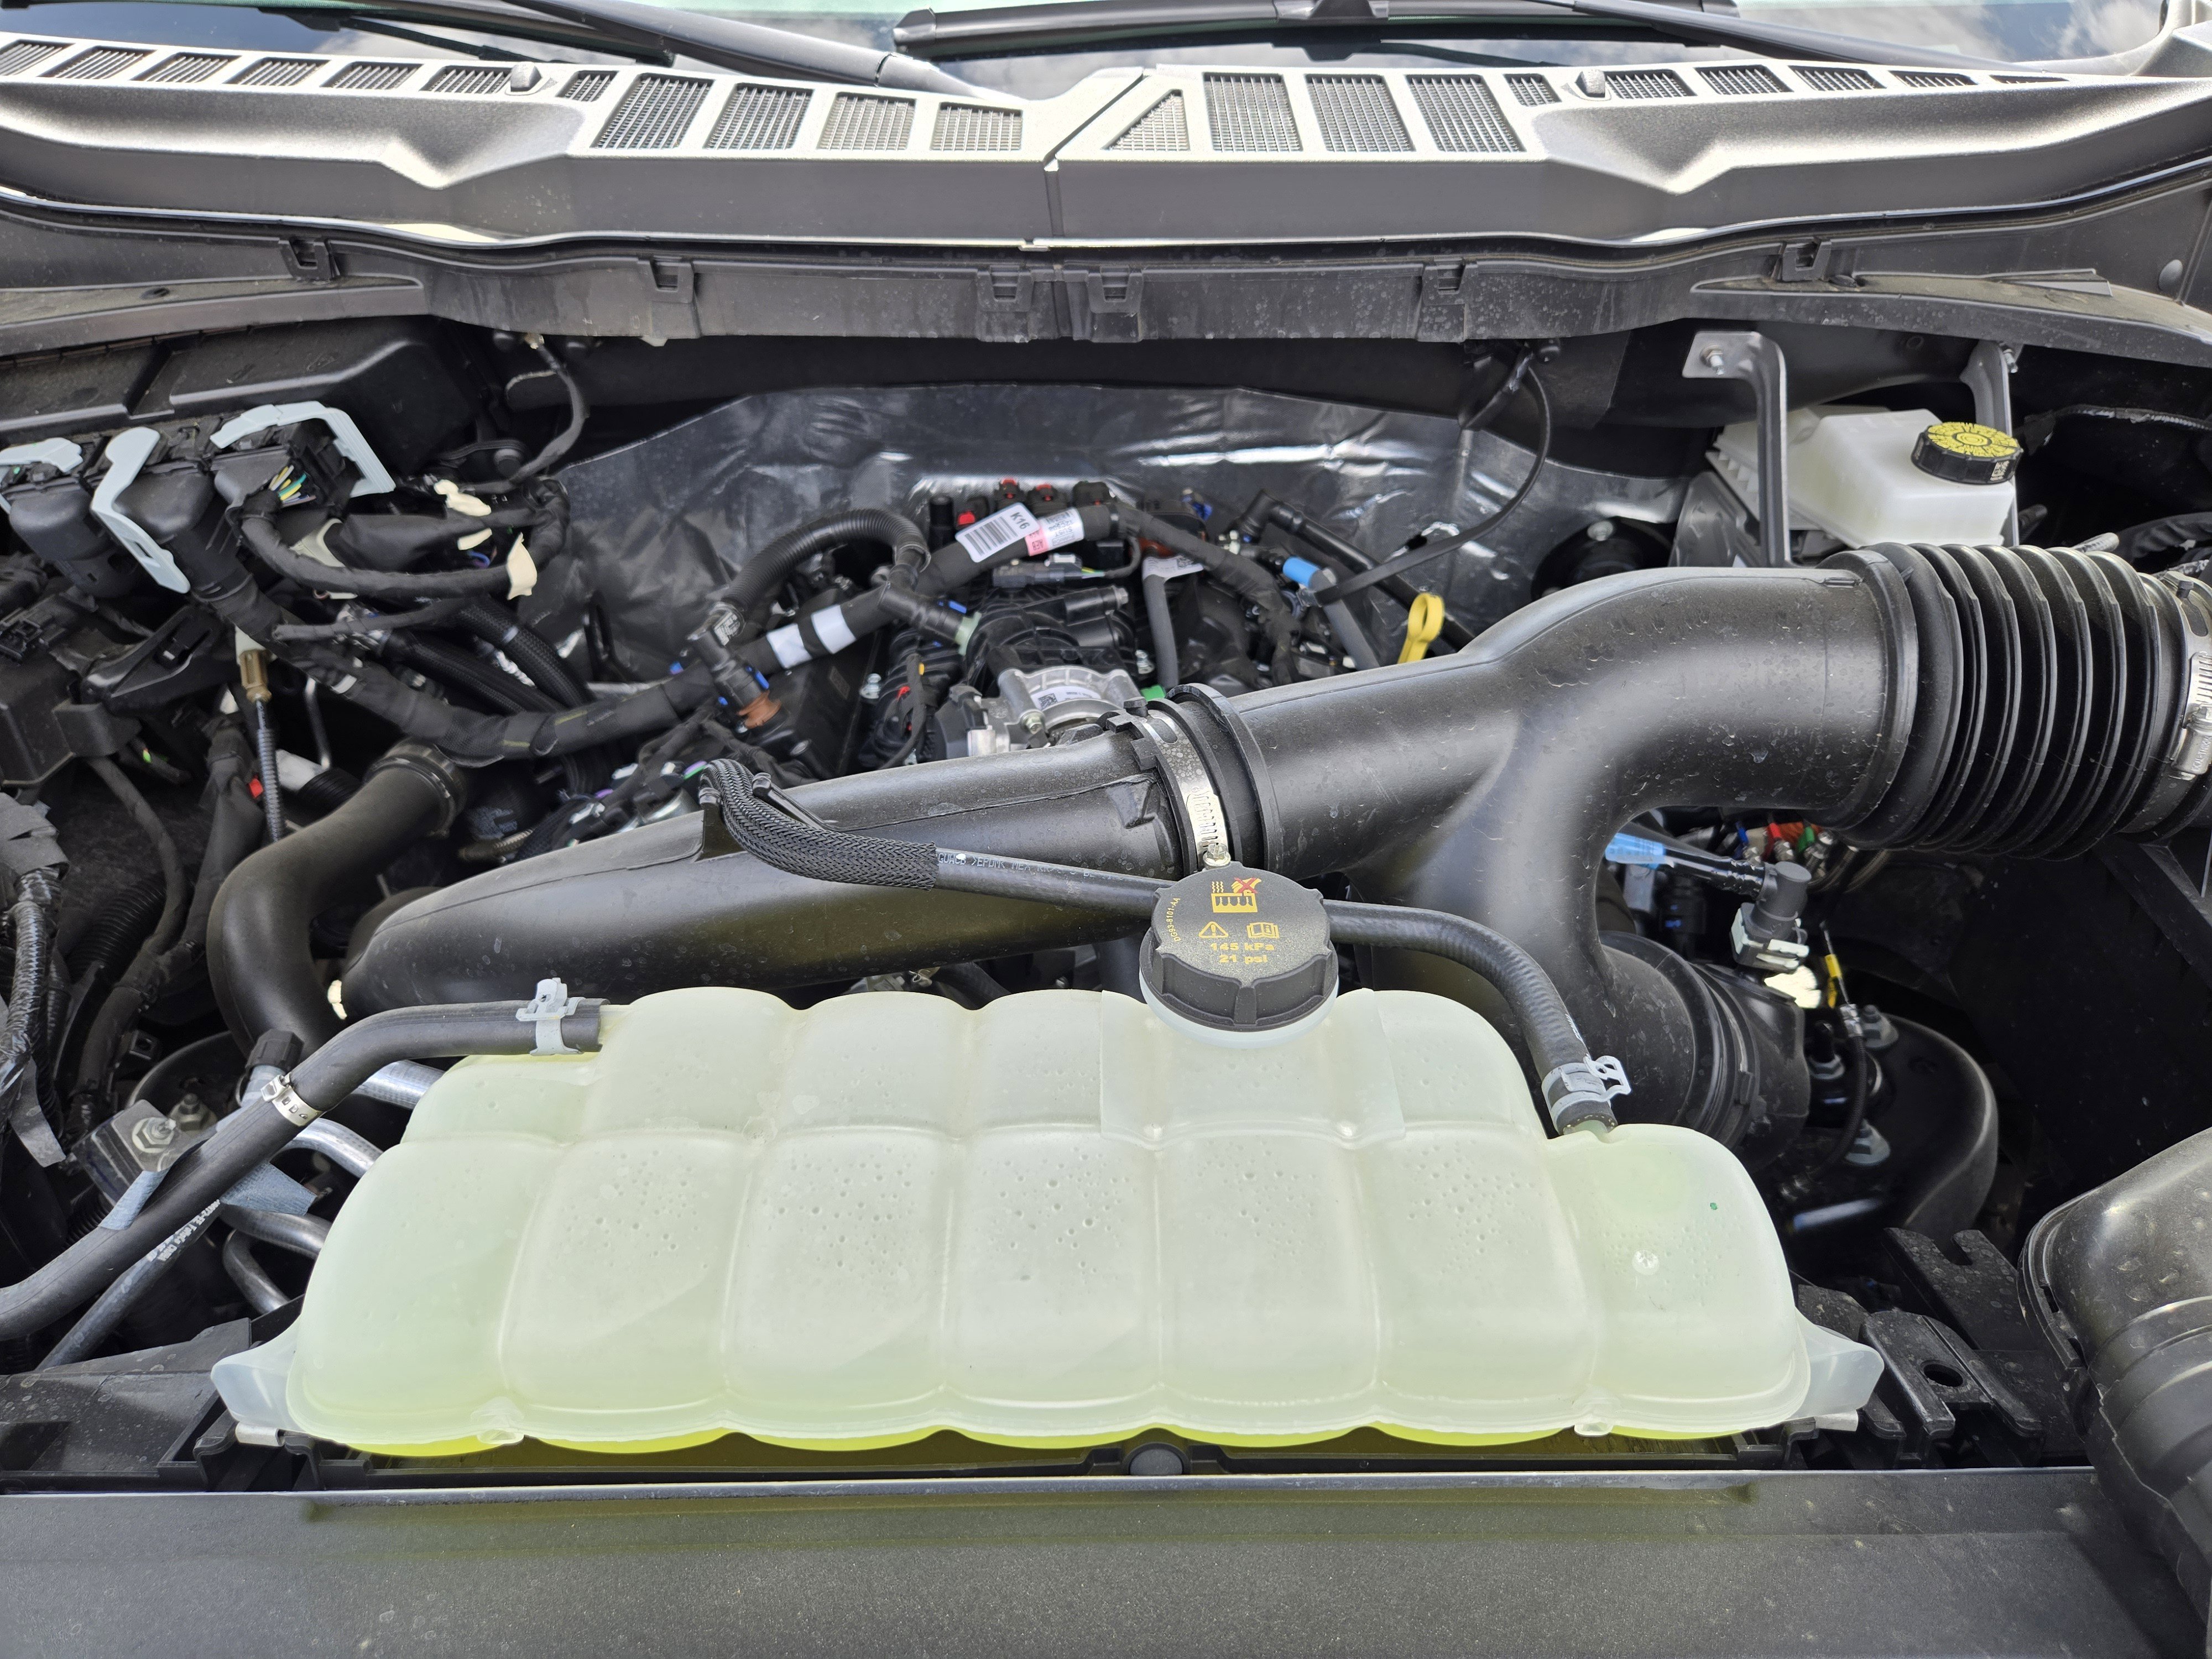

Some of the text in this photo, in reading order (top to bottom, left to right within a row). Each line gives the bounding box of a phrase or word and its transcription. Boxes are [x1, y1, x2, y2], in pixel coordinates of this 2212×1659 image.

[1010, 512, 1030, 530] K16
[1166, 897, 1181, 942] DG93-8101-AA
[1210, 942, 1275, 951] 145 kPa
[1219, 954, 1268, 964] 21 psi
